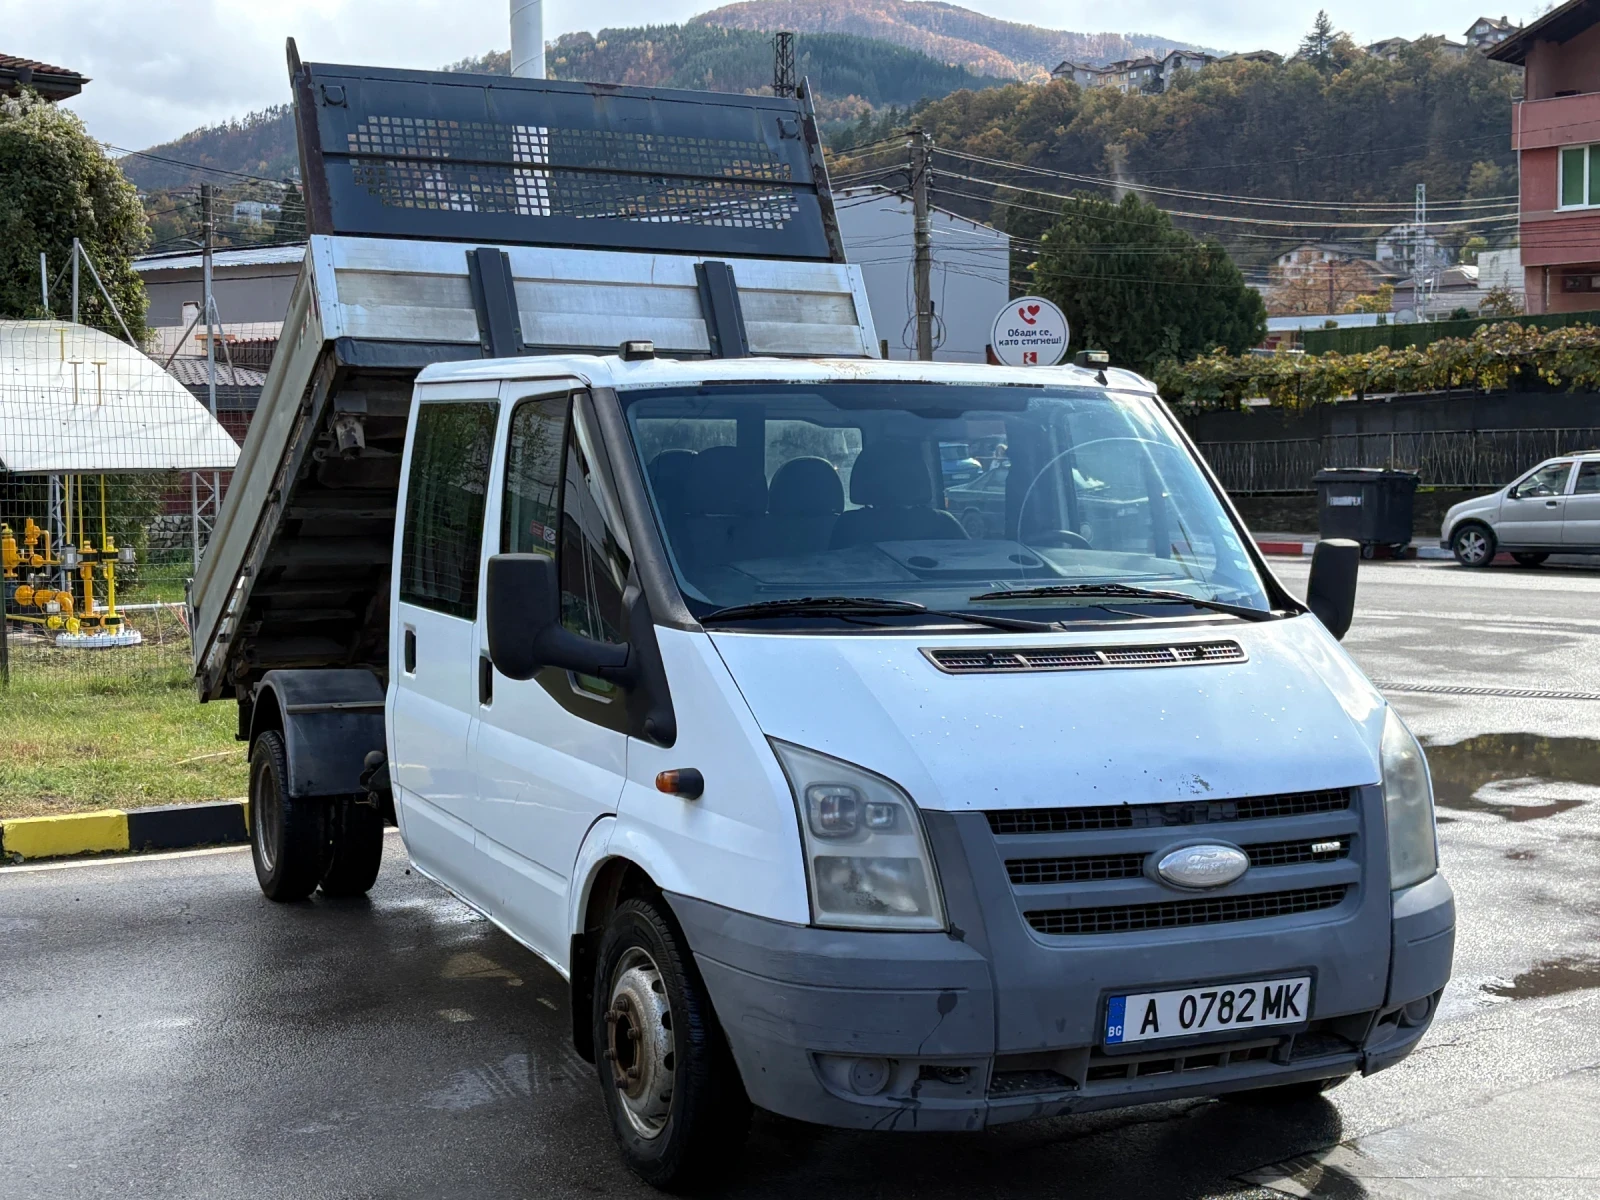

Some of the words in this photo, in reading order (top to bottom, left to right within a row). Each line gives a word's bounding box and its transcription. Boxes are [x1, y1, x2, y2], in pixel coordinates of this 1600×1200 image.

[1007, 329, 1037, 337] Обади
[1021, 336, 1062, 345] стигнеш!
[1139, 998, 1160, 1035] A
[1107, 1025, 1122, 1038] BG
